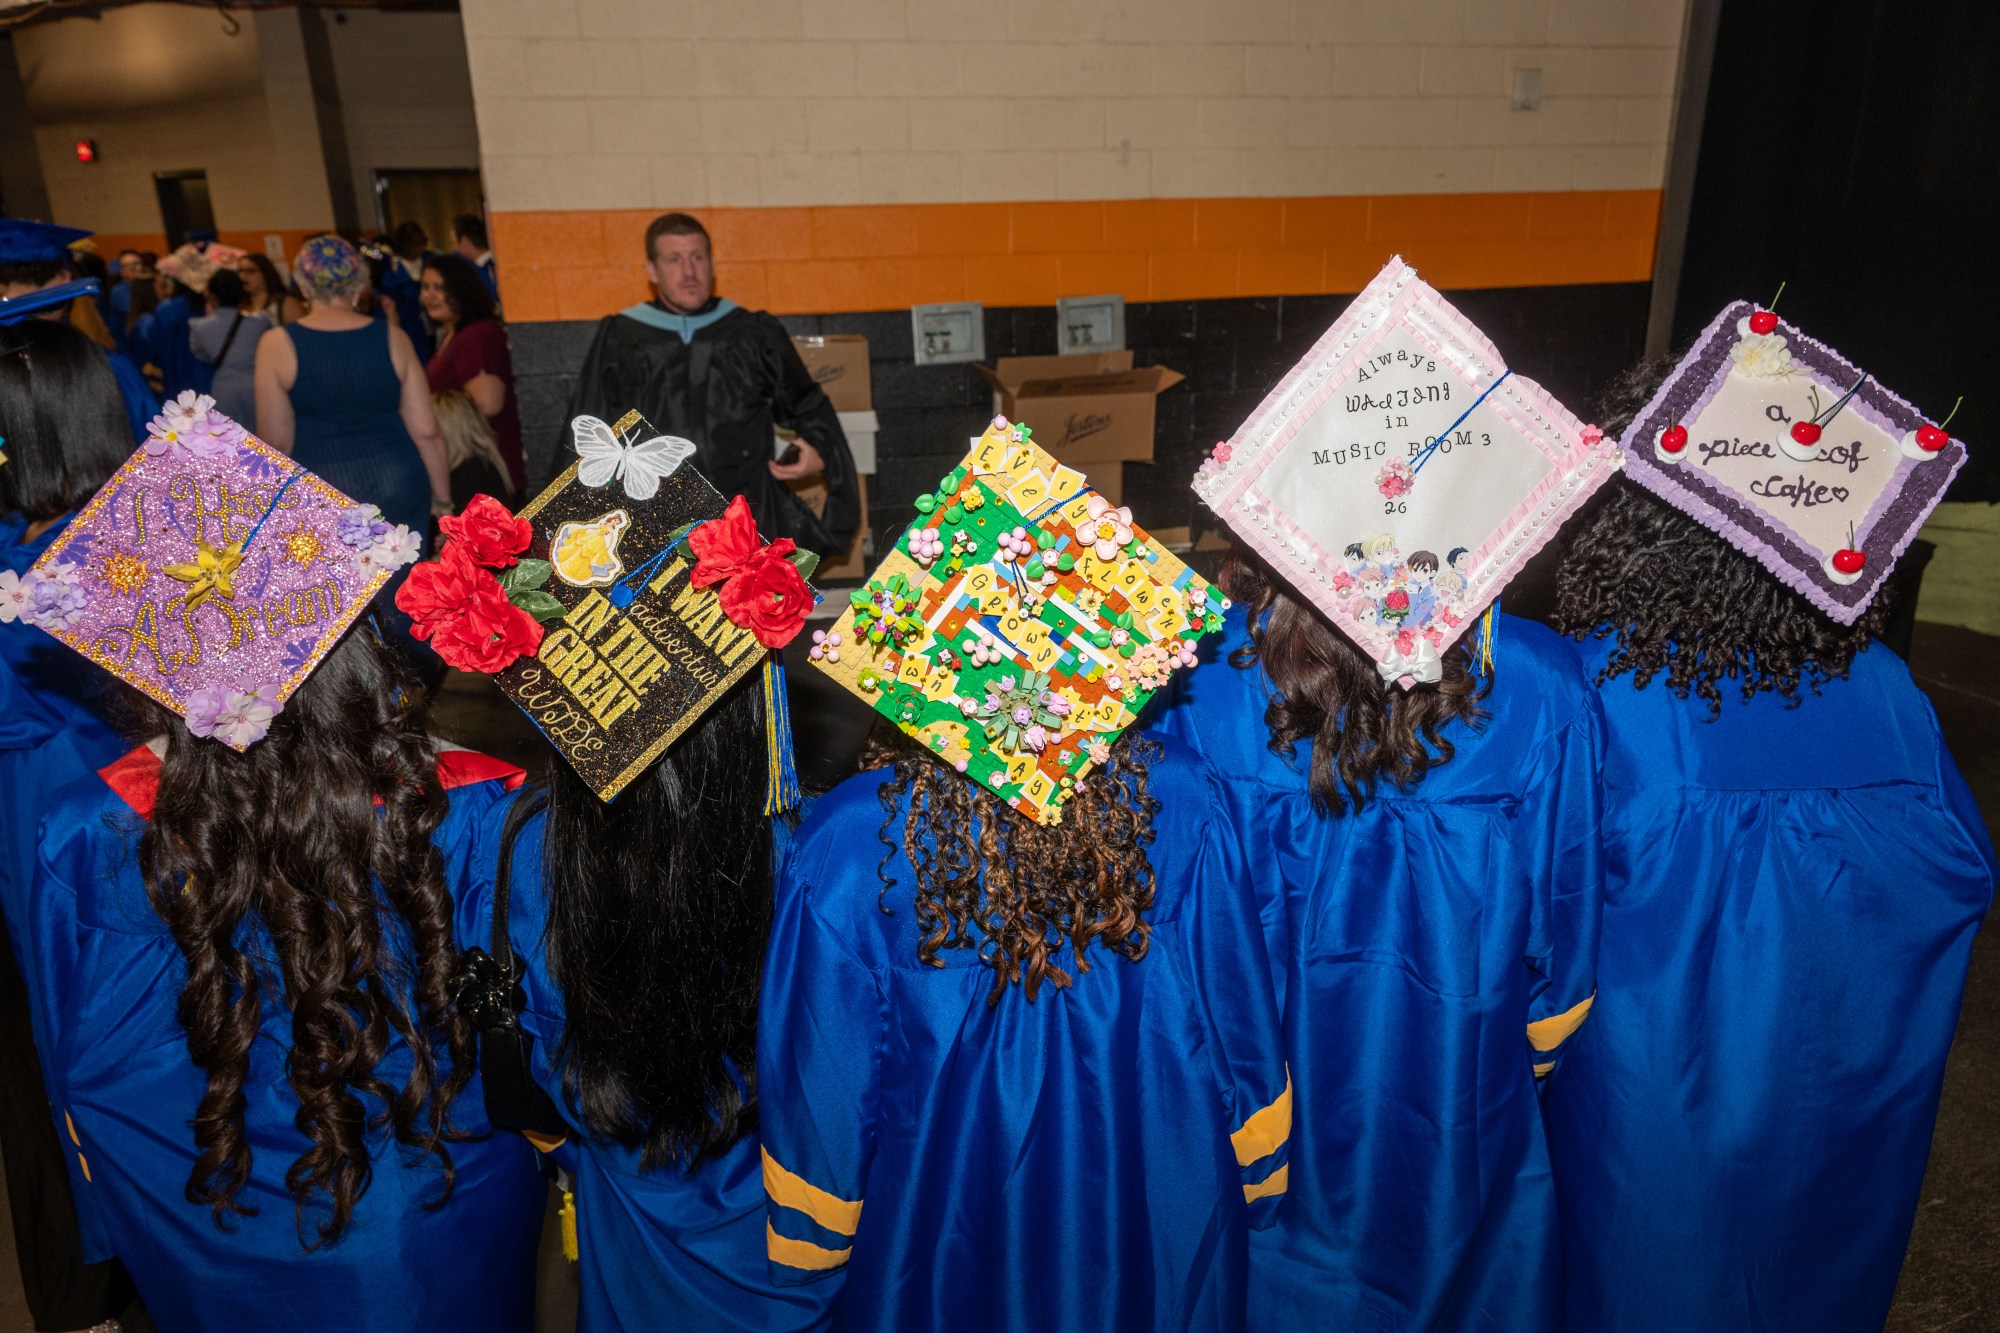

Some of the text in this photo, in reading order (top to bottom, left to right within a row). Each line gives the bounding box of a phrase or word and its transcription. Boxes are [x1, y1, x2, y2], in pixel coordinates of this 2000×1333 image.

[1357, 349, 1435, 382] Always
[1385, 415, 1409, 429] in
[1766, 405, 1791, 423] a
[1312, 430, 1491, 466] MUSIC ROOM 3
[1699, 437, 1776, 465] piece
[135, 473, 298, 546] I Have
[1384, 501, 1407, 515] 26
[93, 579, 342, 675] A Dream
[649, 556, 764, 668] I WANT
[563, 588, 672, 696] IN THE
[539, 628, 642, 730] GREAT
